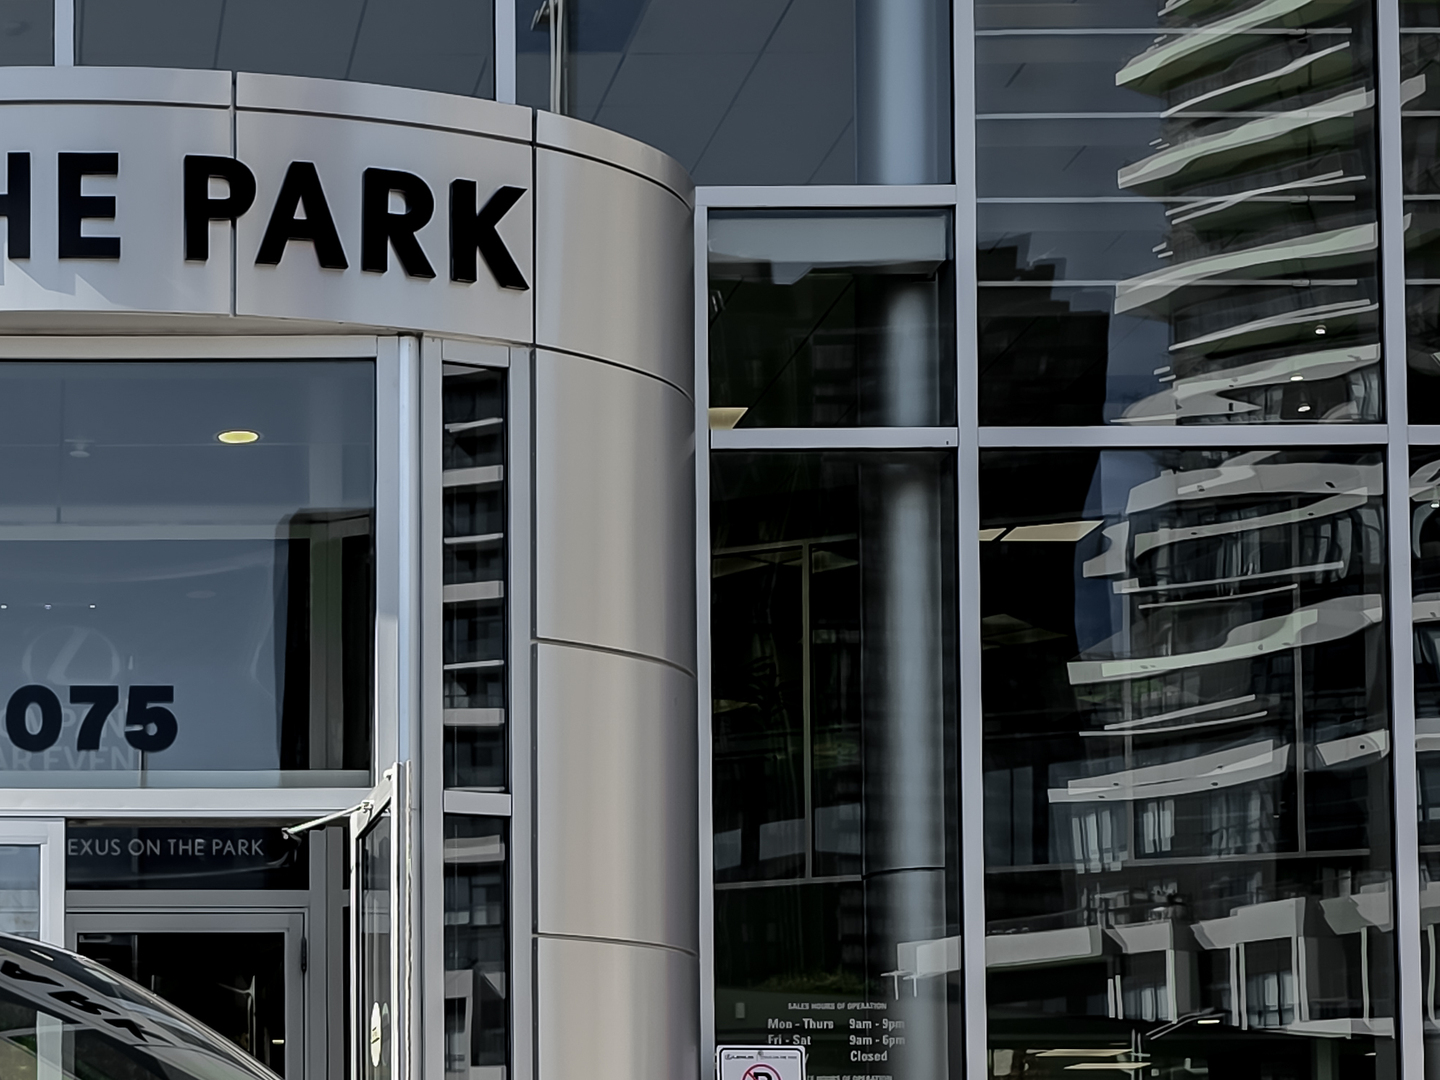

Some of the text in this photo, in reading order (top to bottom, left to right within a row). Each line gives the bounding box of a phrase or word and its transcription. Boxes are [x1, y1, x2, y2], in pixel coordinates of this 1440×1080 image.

[183, 154, 531, 292] PARK
[67, 838, 265, 857] EXUS ON THE PARK
[767, 1018, 793, 1029] Mon
[803, 1018, 835, 1029] Thurs
[849, 1018, 872, 1029] 9am
[882, 1018, 906, 1032] 9pm
[767, 1034, 782, 1045] Fri
[792, 1034, 812, 1045] Sat
[849, 1034, 873, 1045] 9am
[882, 1034, 906, 1048] 6pm
[850, 1050, 888, 1062] Closed
